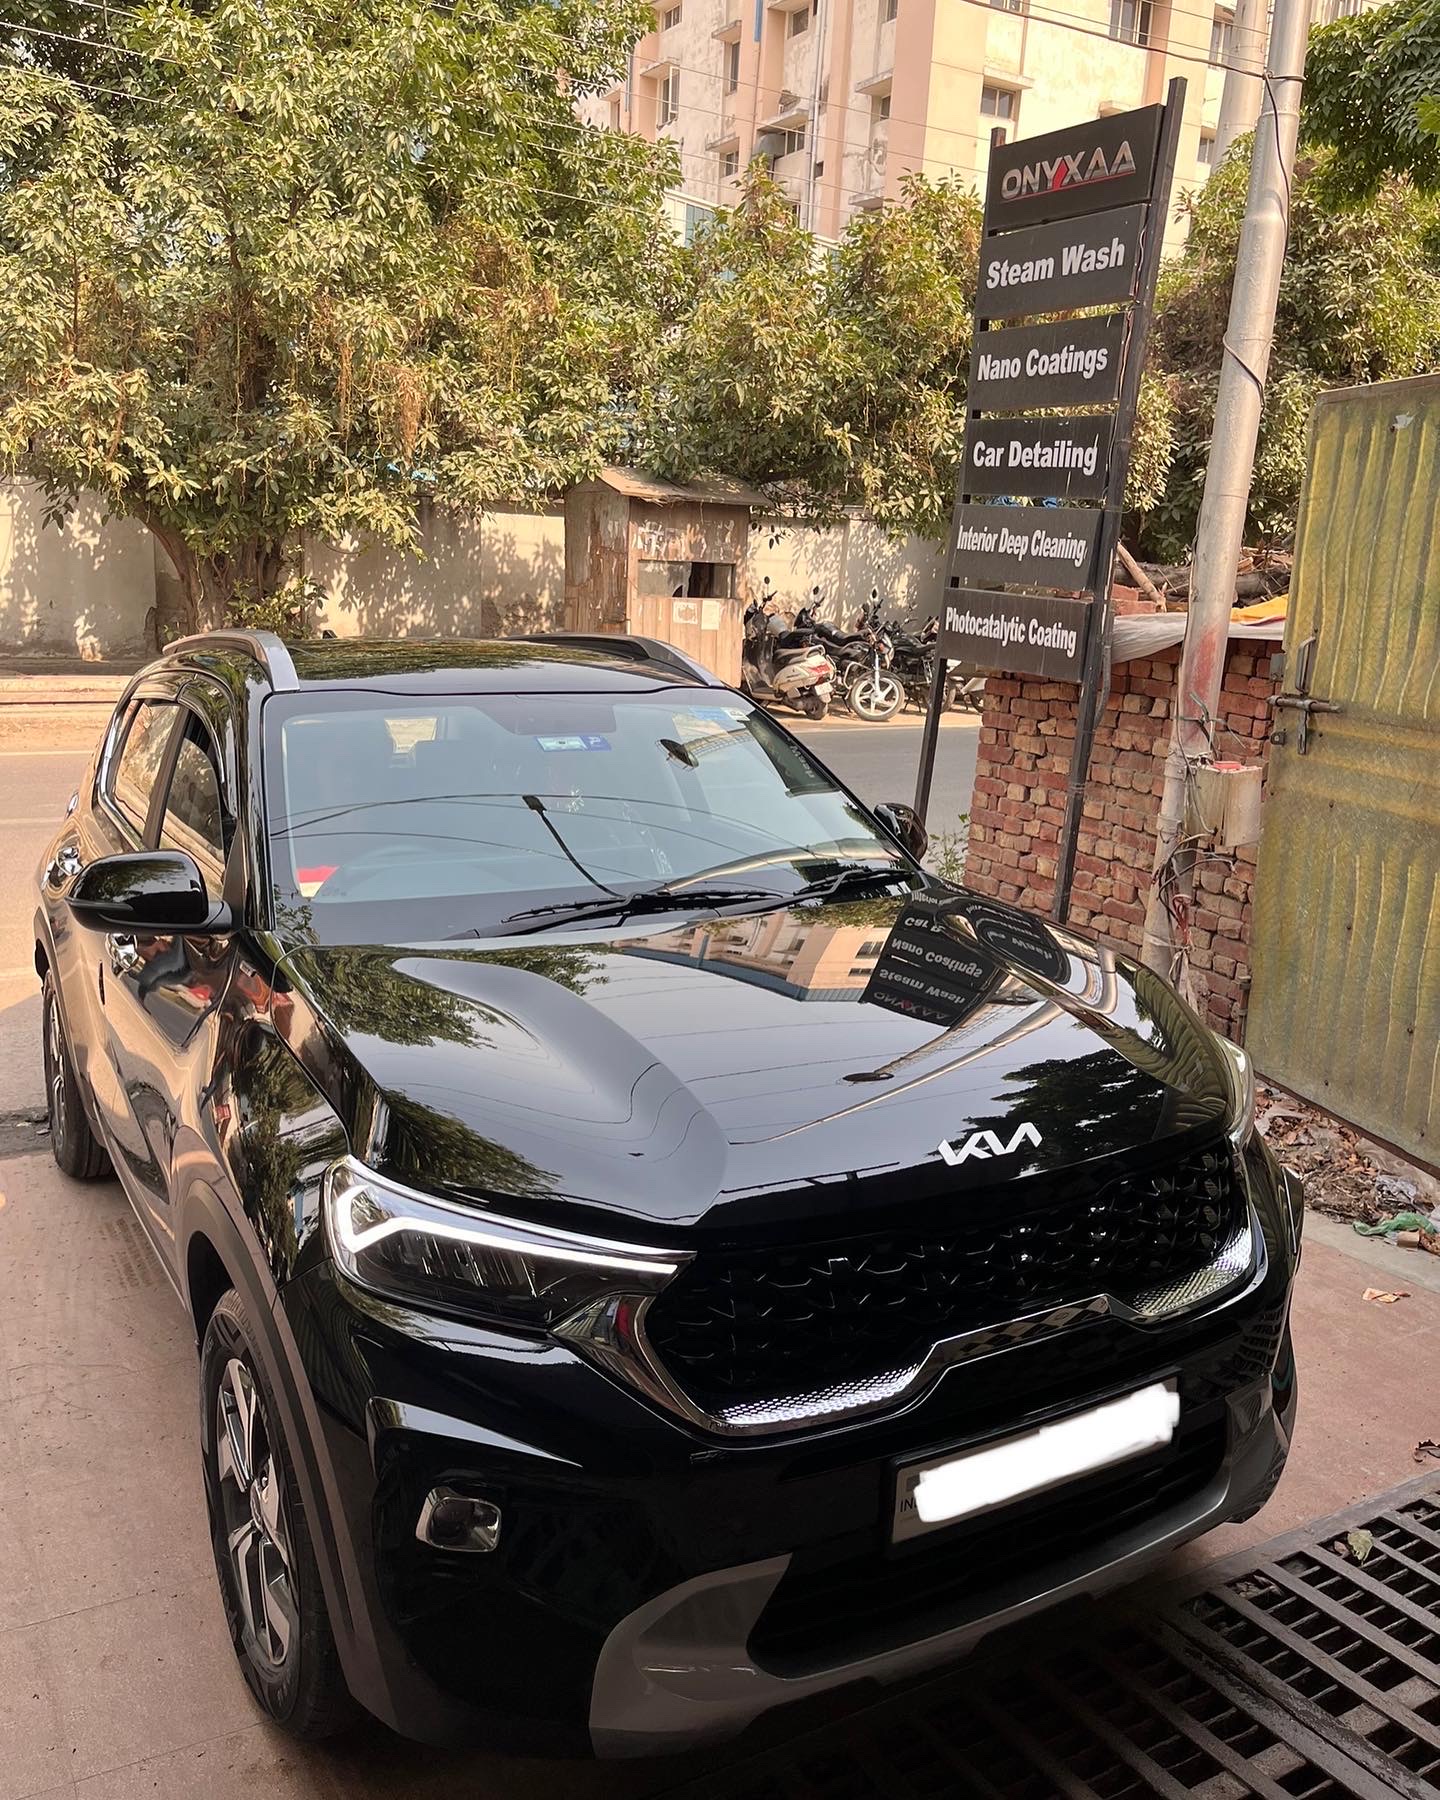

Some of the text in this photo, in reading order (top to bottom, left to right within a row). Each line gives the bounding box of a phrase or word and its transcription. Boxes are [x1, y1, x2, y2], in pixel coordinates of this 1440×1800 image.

[1001, 141, 1136, 200] ONYXAA
[986, 237, 1125, 289] Steam Wash
[977, 345, 1108, 381] Nano Coatings
[973, 440, 1098, 476] Car Detailing
[956, 525, 1087, 567] Interior Deep Cleaning
[945, 606, 1077, 658] Photocatalytic Coating
[937, 1121, 1043, 1167] KIA
